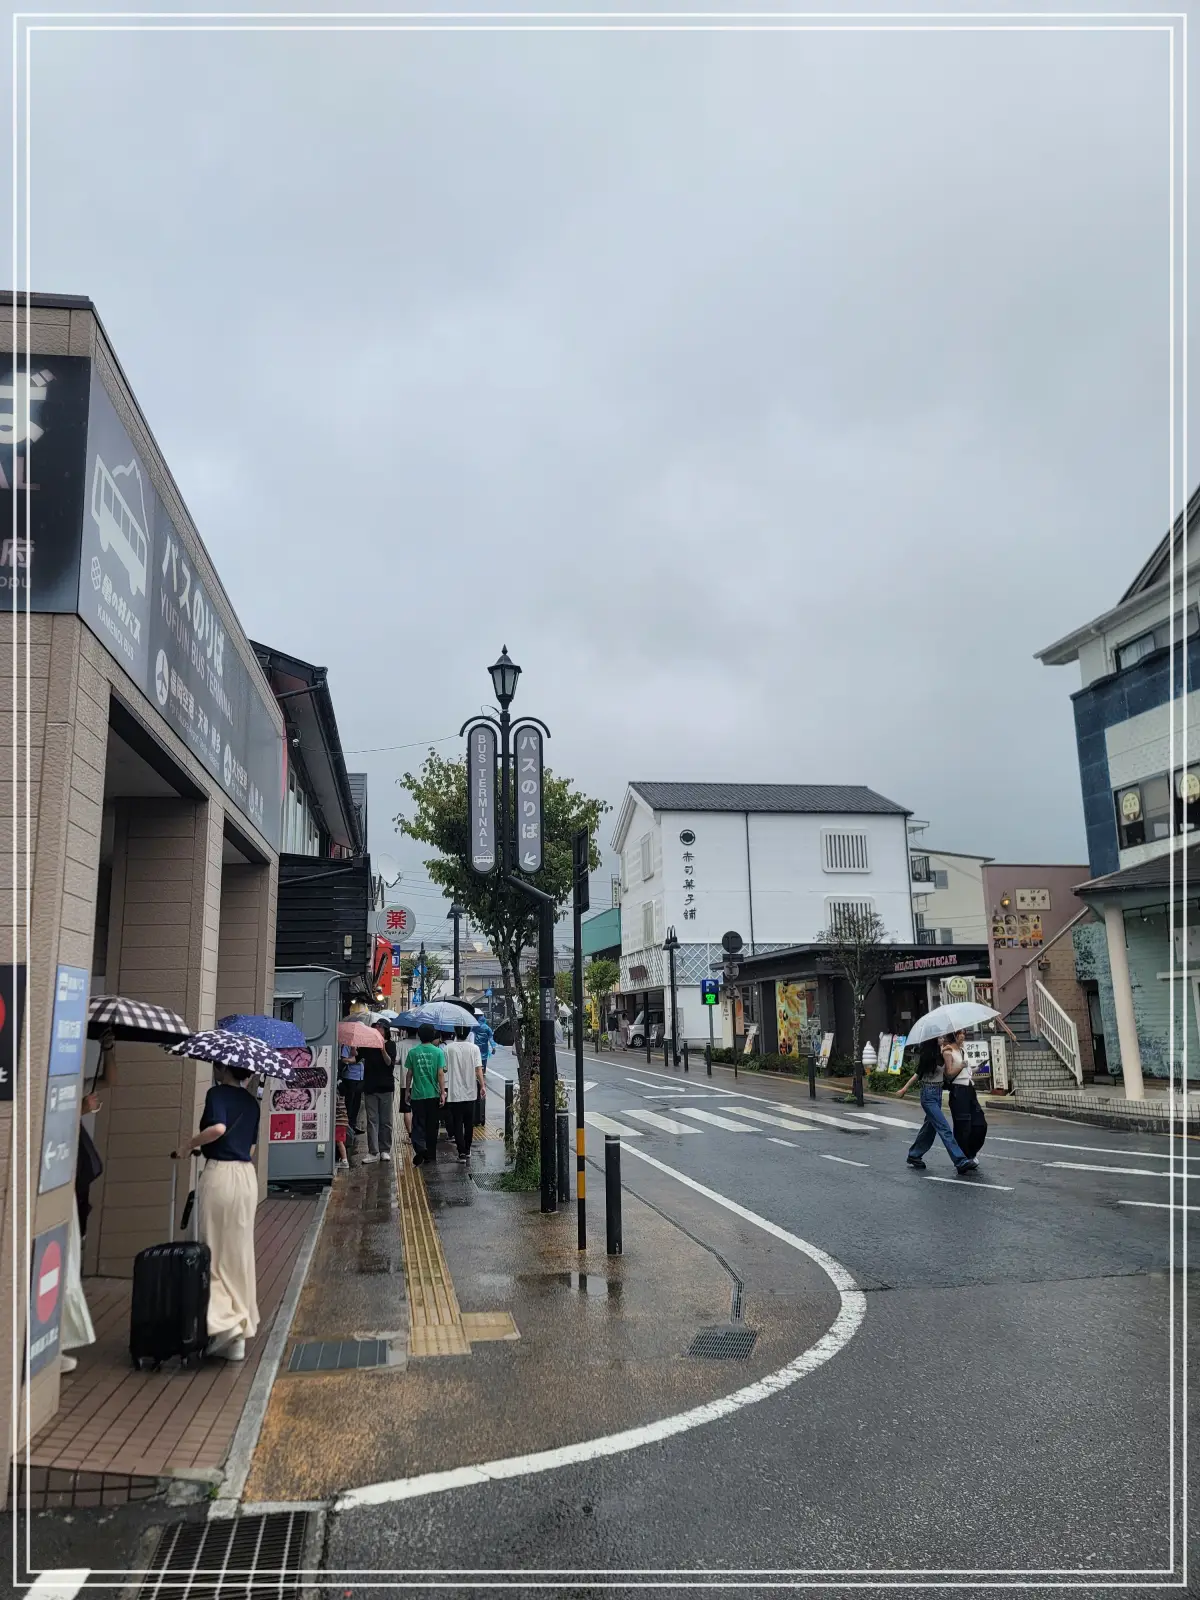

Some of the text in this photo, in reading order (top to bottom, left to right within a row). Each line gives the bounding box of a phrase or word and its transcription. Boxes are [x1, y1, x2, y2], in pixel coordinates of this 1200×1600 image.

[97, 603, 134, 661] KAMENOI BUS
[162, 535, 225, 678] バスのりば
[160, 587, 190, 656] YUFUIN
[191, 639, 205, 681] BUS
[206, 663, 234, 727] TERMINAL
[477, 734, 488, 848] BUS TERMINAL
[520, 736, 539, 840] バスのりば
[386, 909, 407, 930] 薬
[705, 980, 716, 992] P
[966, 1043, 975, 1051] 2F
[967, 1050, 988, 1059] 営業中
